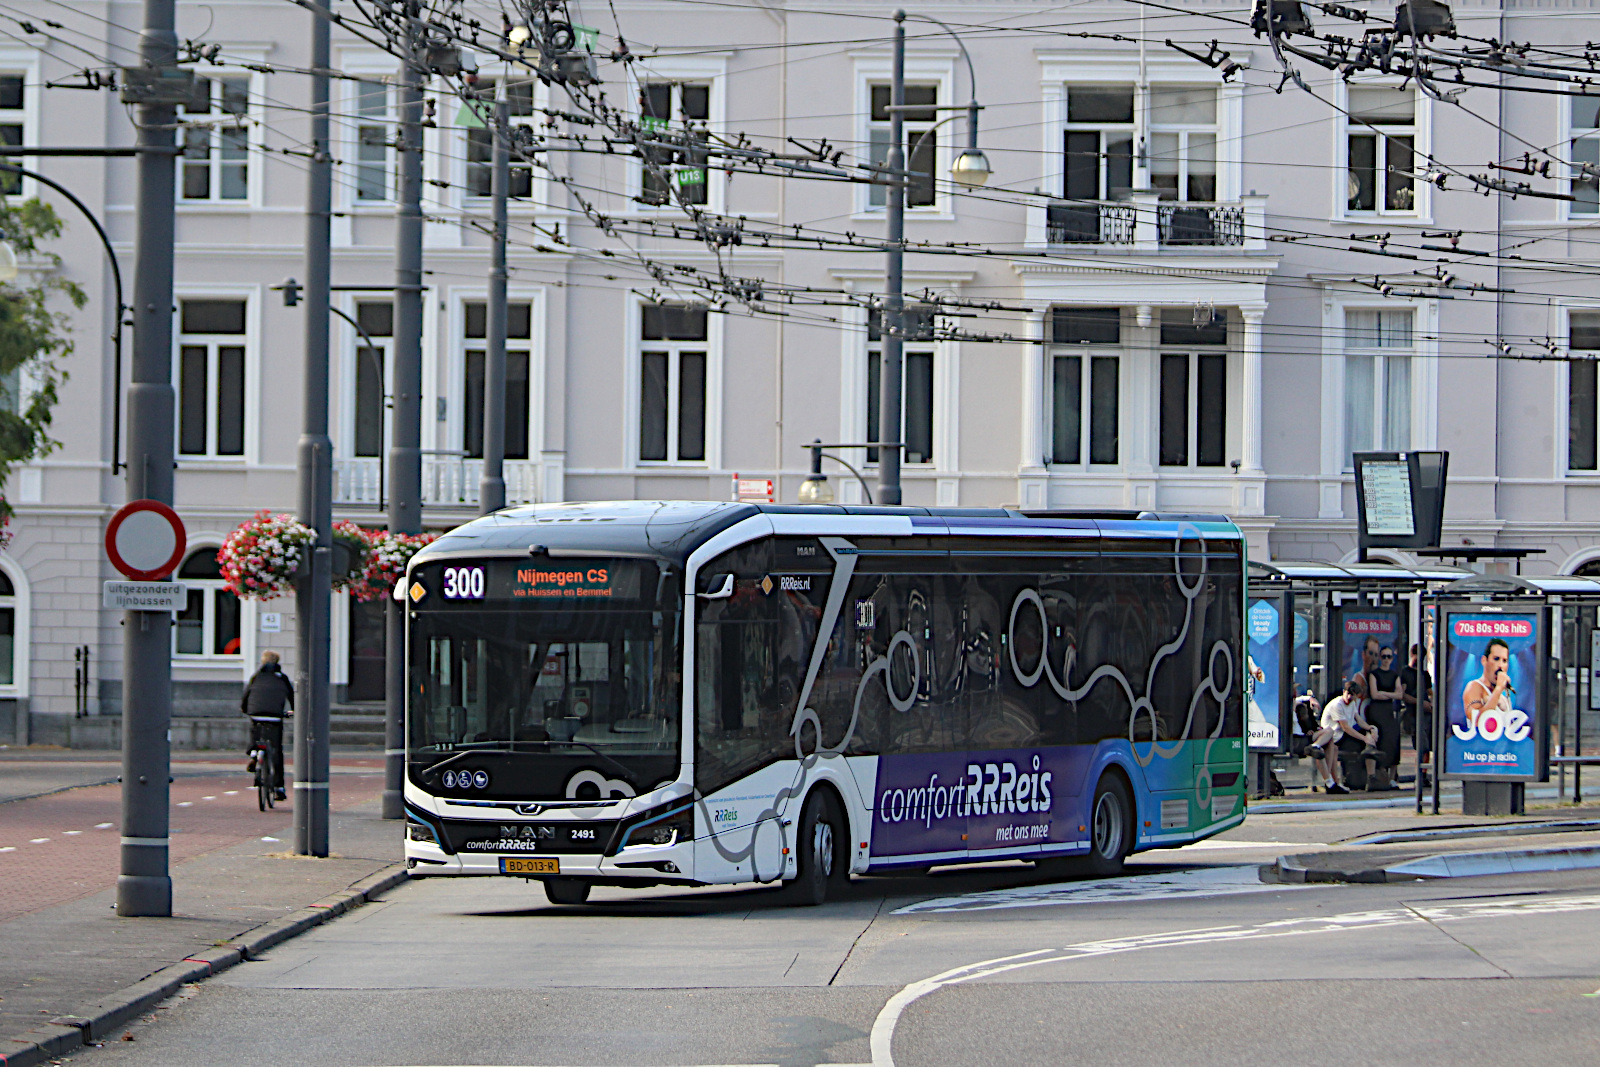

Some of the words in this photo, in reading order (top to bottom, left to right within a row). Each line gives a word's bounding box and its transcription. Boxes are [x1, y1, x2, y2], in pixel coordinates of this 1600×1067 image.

[680, 170, 701, 182] U13
[796, 546, 816, 556] MAN
[444, 567, 484, 599] 300
[517, 569, 583, 586] Nijmegen
[586, 569, 608, 582] CS
[780, 576, 811, 590] RRReis.nl
[108, 585, 180, 595] uitgezonderd
[513, 588, 526, 596] via
[528, 588, 562, 596] Huissen
[576, 587, 612, 596] Bemmel
[116, 596, 172, 607] lijnbussen
[1347, 621, 1358, 631] 70s
[1358, 621, 1369, 631] 80s
[1369, 621, 1380, 631] 90s
[1380, 620, 1391, 631] hits
[1459, 623, 1474, 633] 70s
[1476, 623, 1492, 633] 80s
[1493, 623, 1510, 633] 90s
[1511, 623, 1528, 633] hits
[1463, 752, 1476, 761] Nu
[1476, 753, 1487, 763] op
[1487, 752, 1496, 763] je
[1496, 752, 1517, 762] radio
[714, 806, 738, 822] RRReis
[500, 825, 556, 839] MAN
[571, 829, 595, 839] 2491
[996, 824, 1013, 841] met
[1014, 826, 1029, 839] ons
[1030, 824, 1049, 838] mee
[509, 861, 554, 871] BD-013-R
